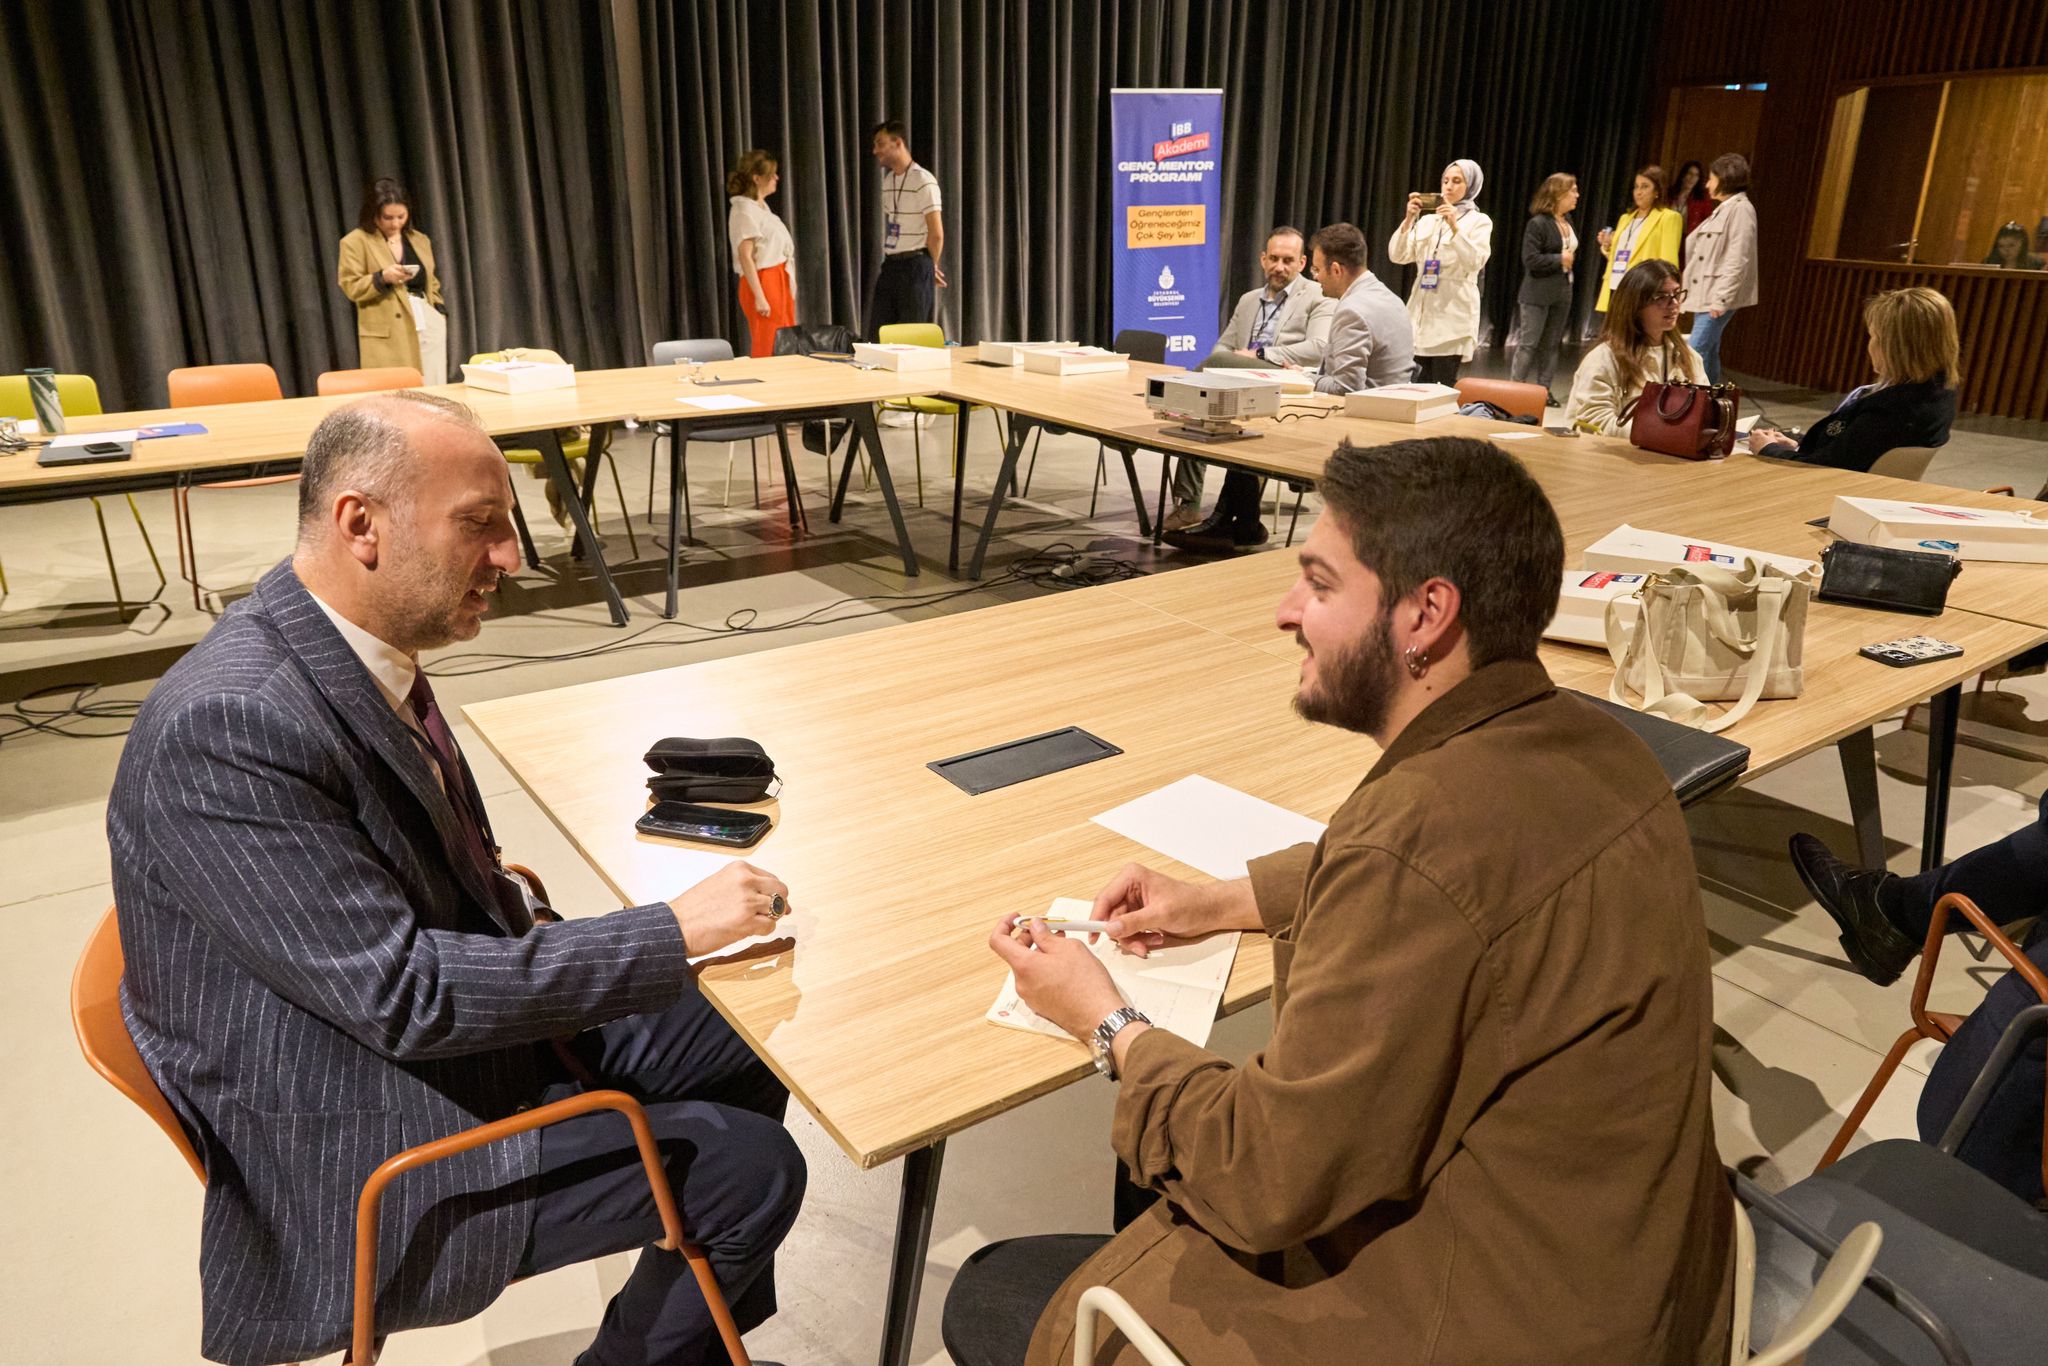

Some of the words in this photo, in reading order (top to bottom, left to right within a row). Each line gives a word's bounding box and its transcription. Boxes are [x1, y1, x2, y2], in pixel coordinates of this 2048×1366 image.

[1171, 122, 1192, 137] İBB
[1157, 139, 1208, 155] Akademi
[1118, 161, 1156, 173] GENÇ
[1158, 161, 1215, 171] MENTOR
[1130, 172, 1203, 183] PROGRAMI
[1138, 209, 1193, 219] Gençlerden
[1130, 219, 1201, 231] Öğreneceğimiz
[1136, 231, 1155, 241] Çok
[1157, 230, 1174, 241] Şey
[1178, 230, 1196, 239] Var!
[1166, 335, 1196, 352] ER
